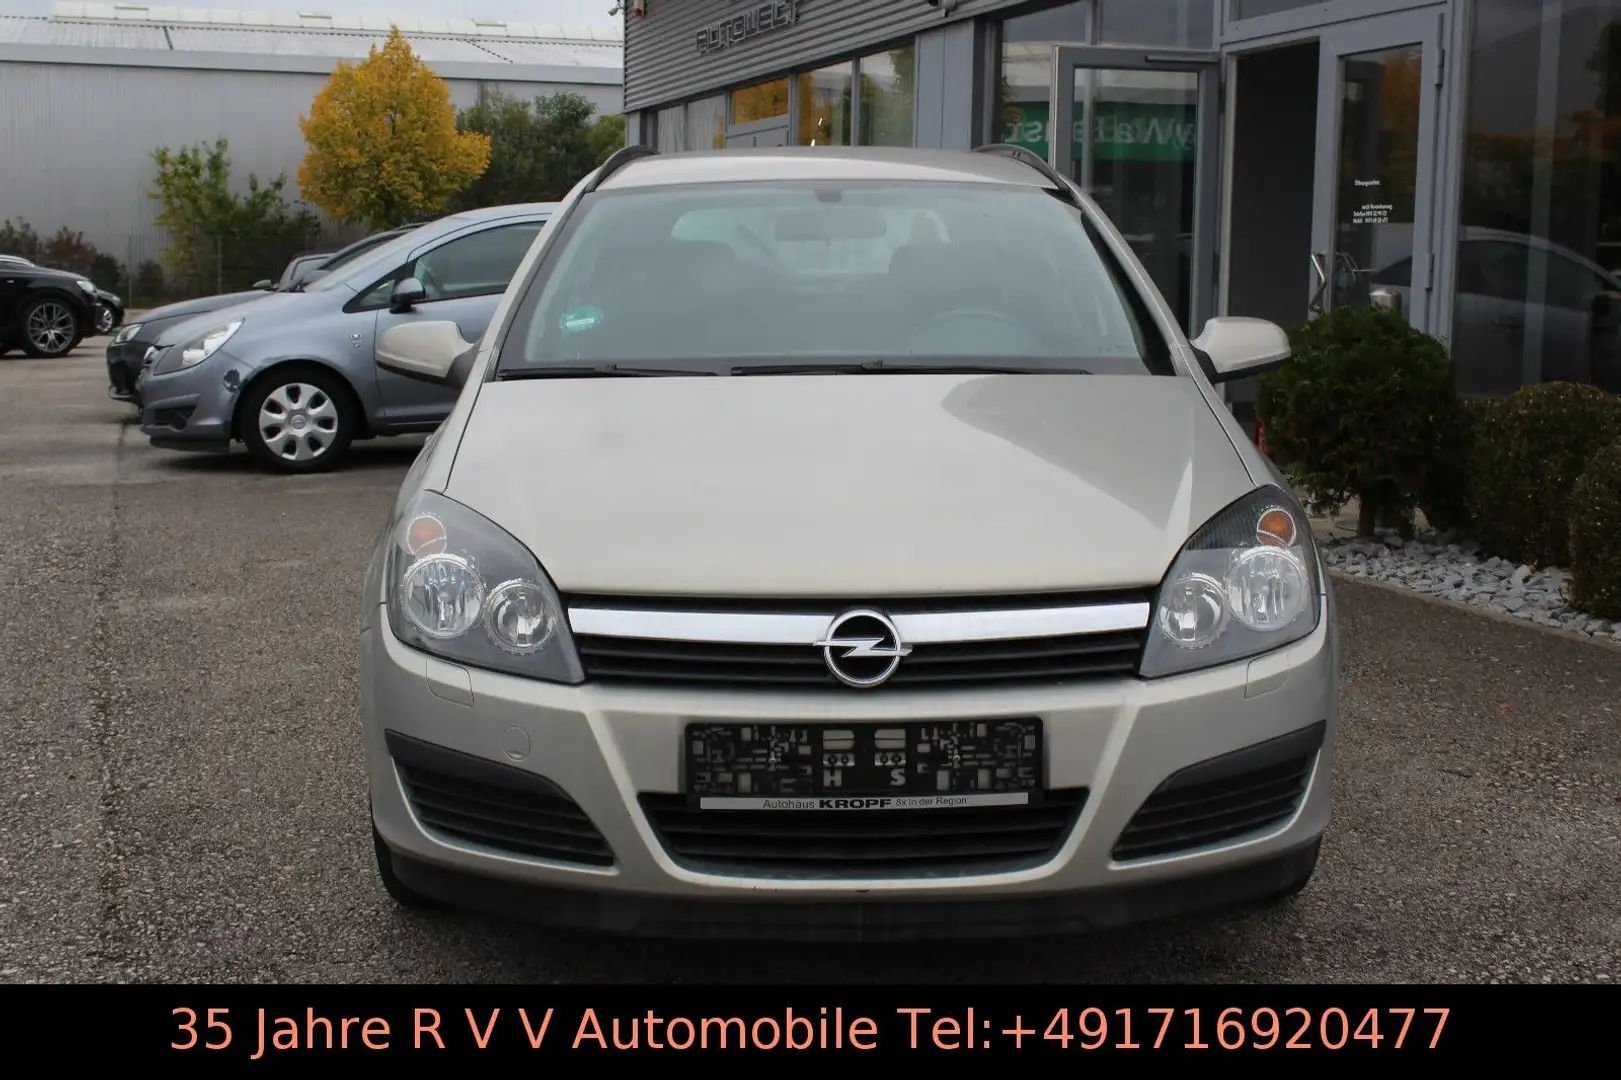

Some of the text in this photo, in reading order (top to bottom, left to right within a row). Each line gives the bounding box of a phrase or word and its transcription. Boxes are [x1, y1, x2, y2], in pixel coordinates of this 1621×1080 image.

[762, 798, 815, 810] Autohaus
[818, 798, 892, 810] KROPF
[909, 798, 918, 807] in
[919, 797, 934, 807] der
[935, 796, 968, 807] Region
